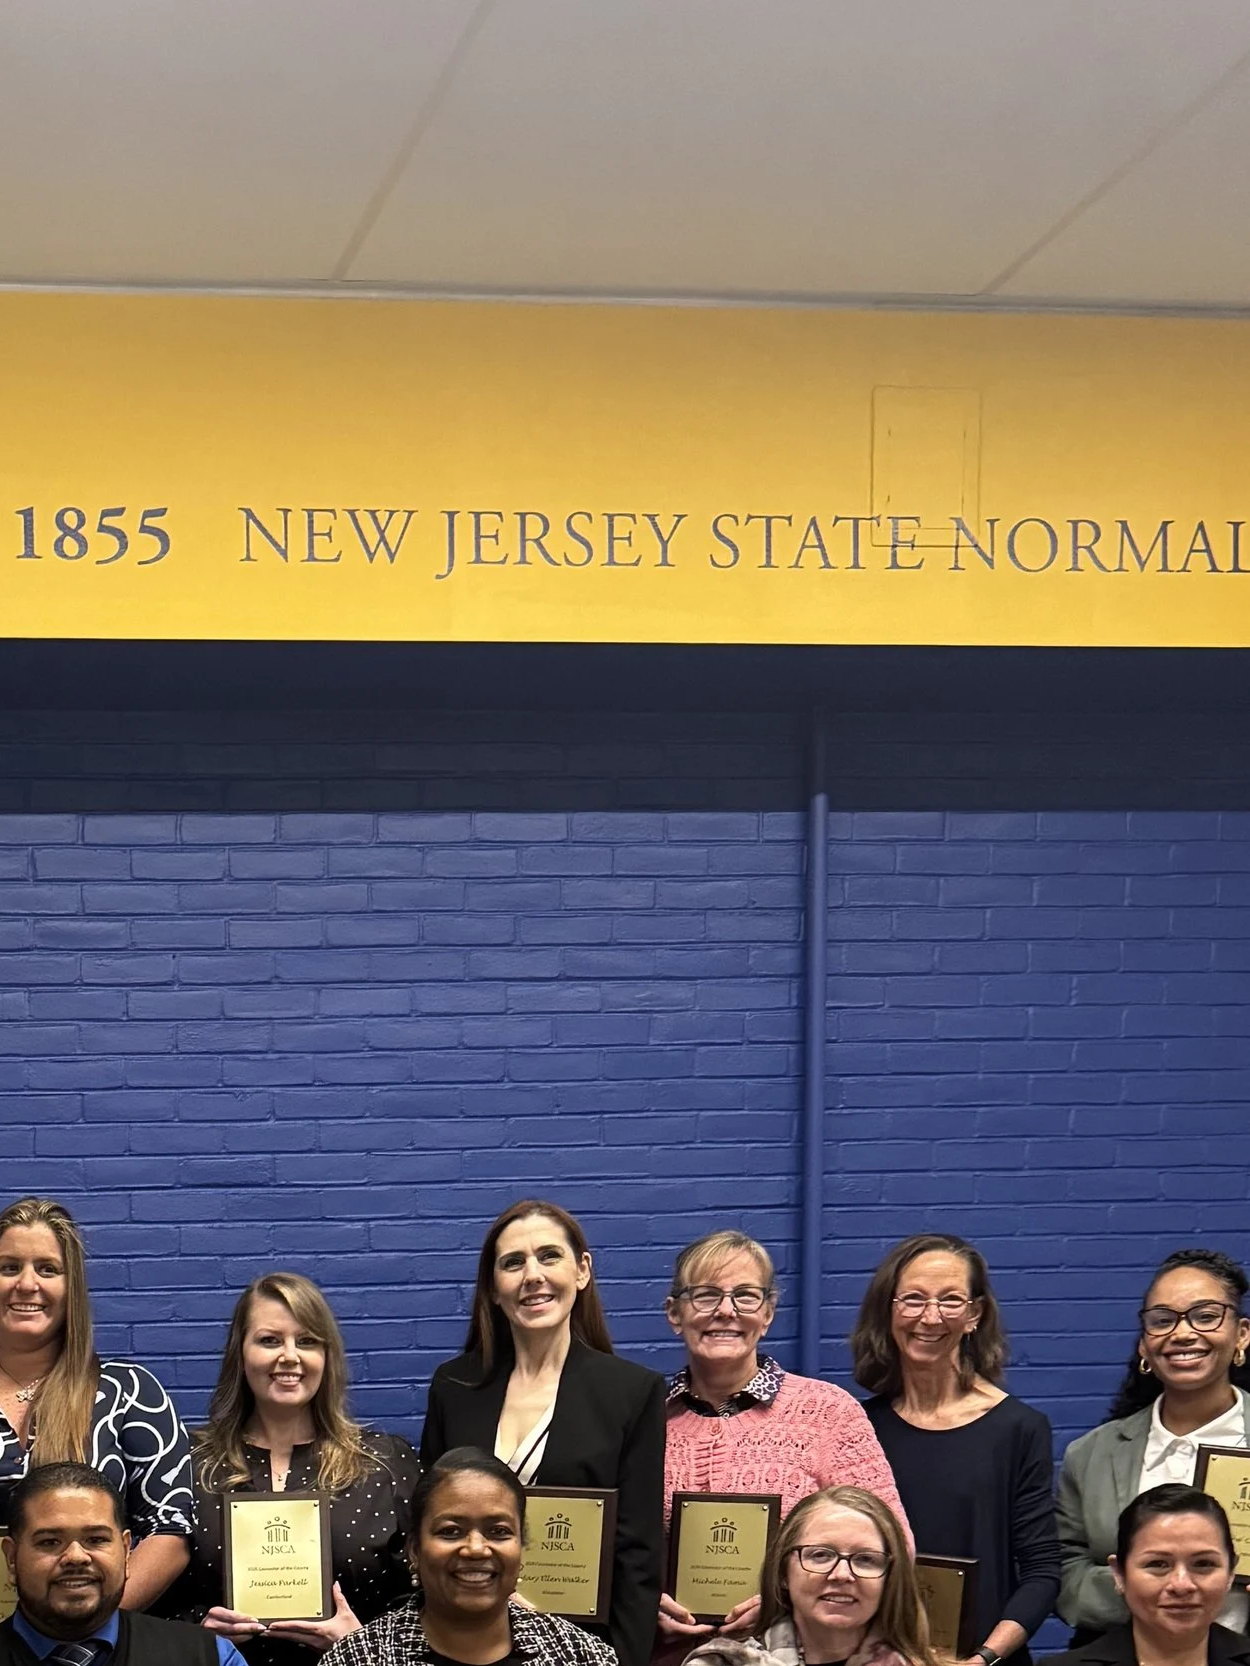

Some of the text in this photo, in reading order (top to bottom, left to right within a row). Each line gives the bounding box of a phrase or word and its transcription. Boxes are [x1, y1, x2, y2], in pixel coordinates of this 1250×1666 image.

[15, 505, 171, 565] 1855
[238, 507, 1250, 579] NEW JERSEY STATE NORMAL
[261, 1545, 296, 1556] NJSCA
[541, 1541, 575, 1552] NJSCA
[705, 1545, 740, 1555] NJSCA
